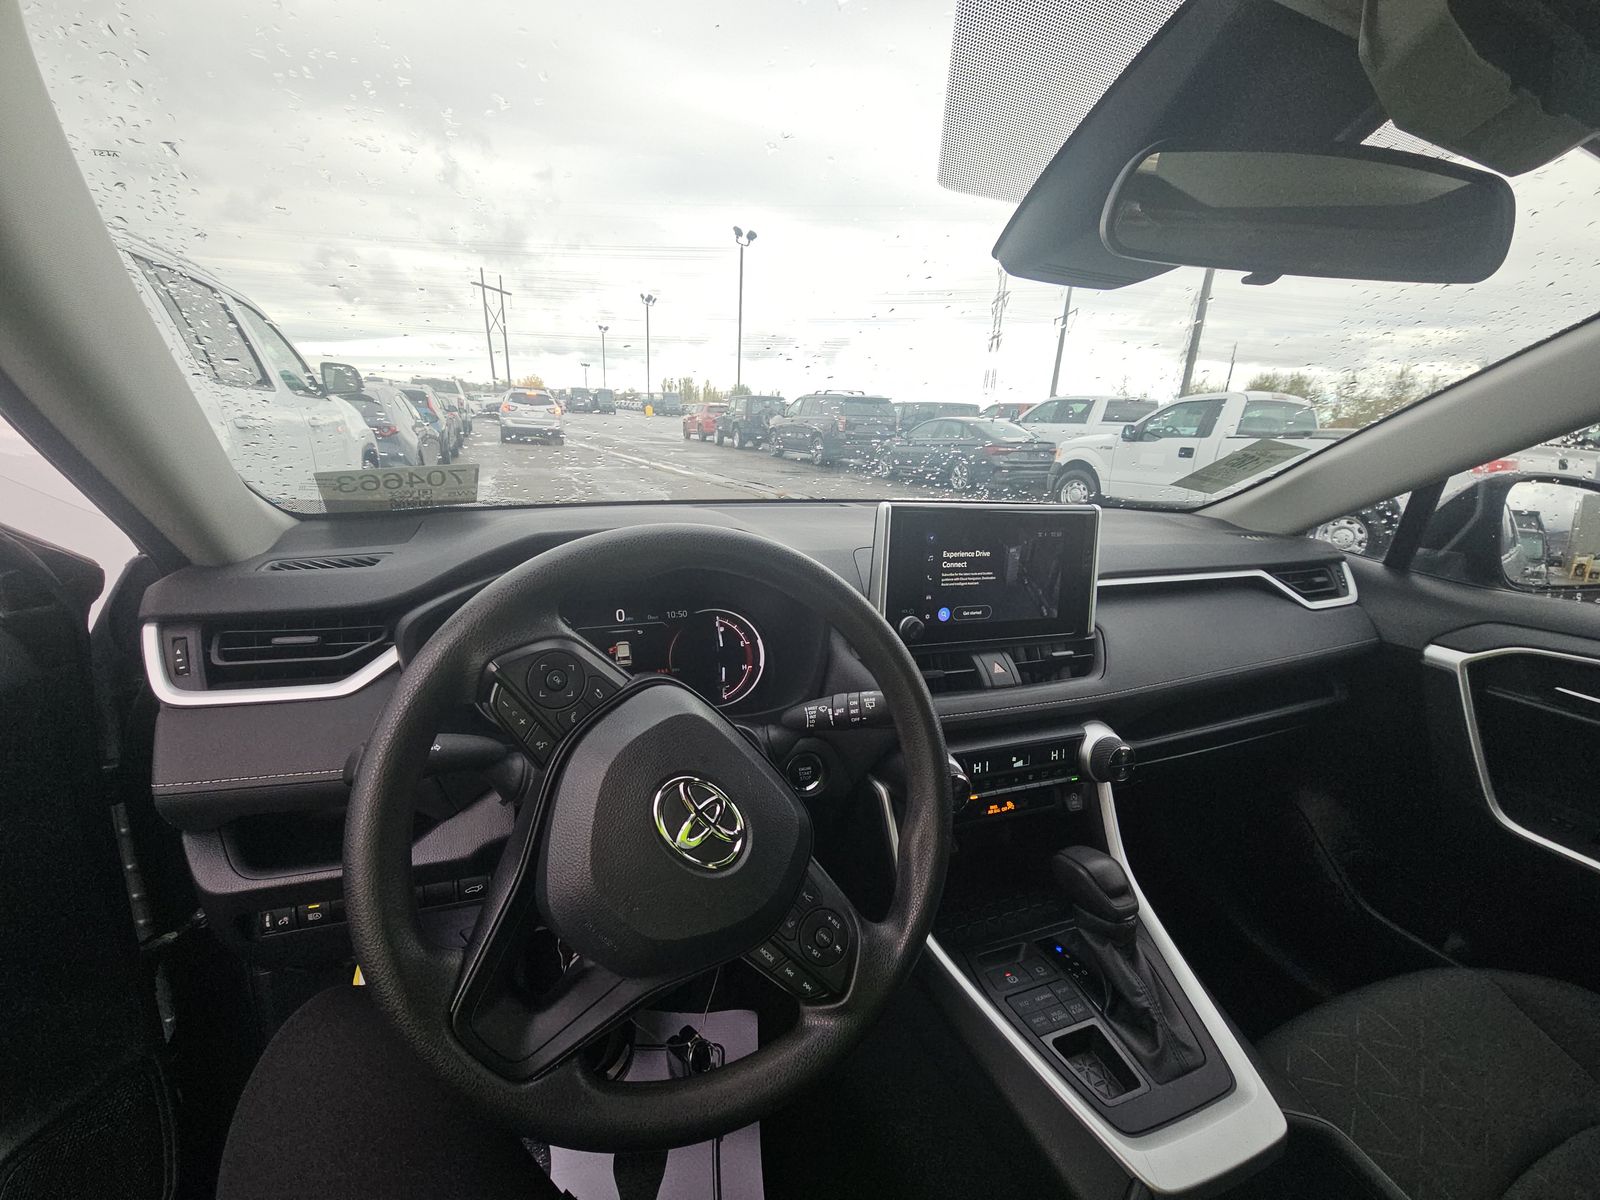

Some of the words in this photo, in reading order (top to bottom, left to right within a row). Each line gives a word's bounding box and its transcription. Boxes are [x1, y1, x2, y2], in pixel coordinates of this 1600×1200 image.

[942, 550, 975, 559] Experience
[616, 608, 625, 622] 0
[666, 610, 688, 619] 10:50
[1051, 748, 1065, 761] HI
[973, 761, 989, 774] HI
